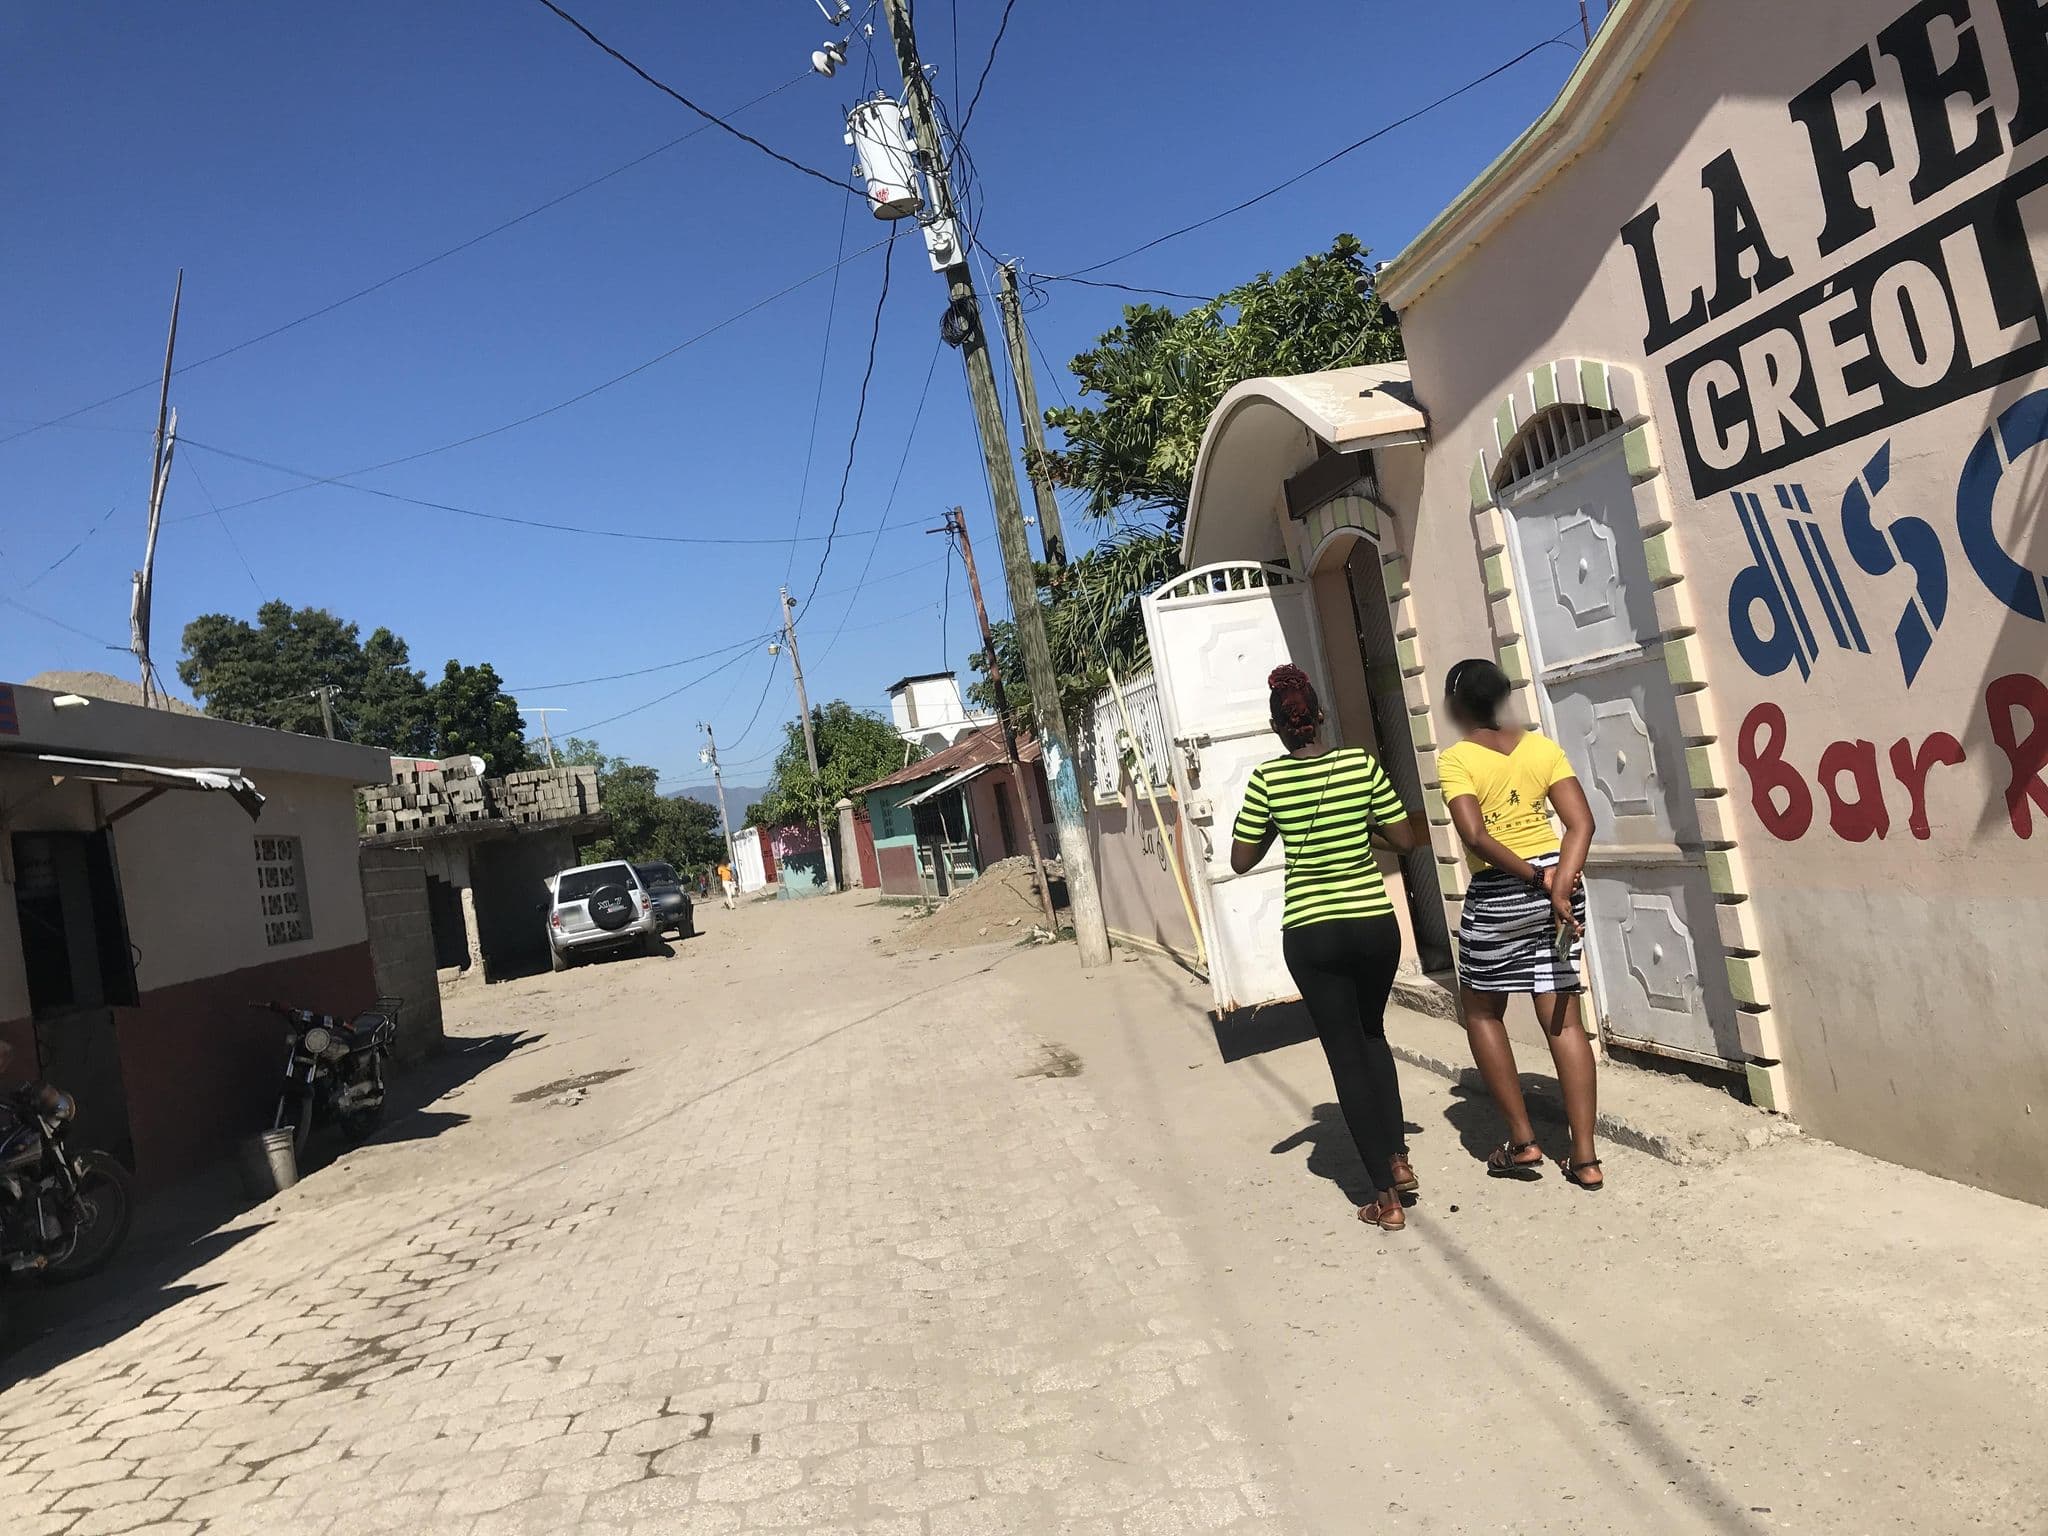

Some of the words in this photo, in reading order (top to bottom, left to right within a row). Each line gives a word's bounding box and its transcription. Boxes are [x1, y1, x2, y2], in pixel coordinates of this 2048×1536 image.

[1620, 148, 1795, 357] LA
[1687, 183, 2048, 470] CRÉOL
[1738, 702, 1967, 843] Bar
